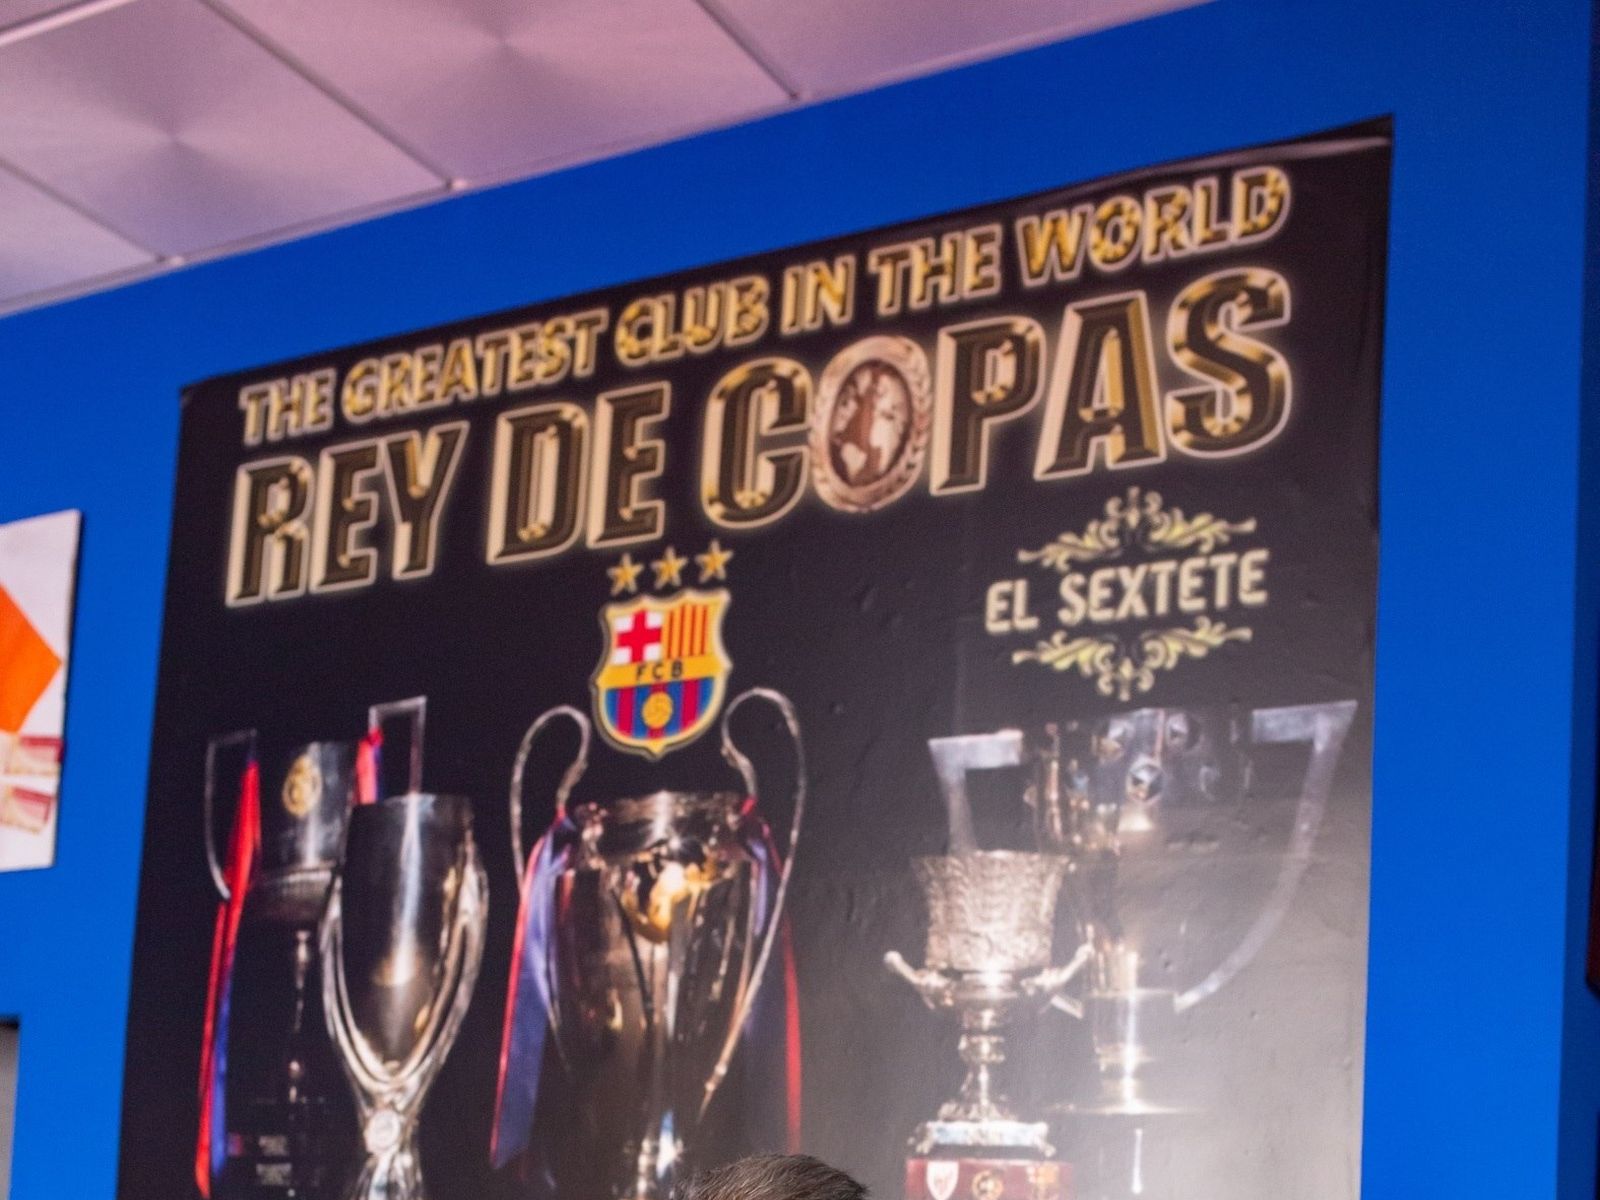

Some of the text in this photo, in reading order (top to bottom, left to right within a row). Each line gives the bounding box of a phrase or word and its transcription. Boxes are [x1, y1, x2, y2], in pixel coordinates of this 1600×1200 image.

[225, 267, 1293, 608] REY DE COPAS
[239, 166, 1292, 446] THE GREATEST CLUB IN THE WORLD
[985, 548, 1270, 634] EL SEXTETE
